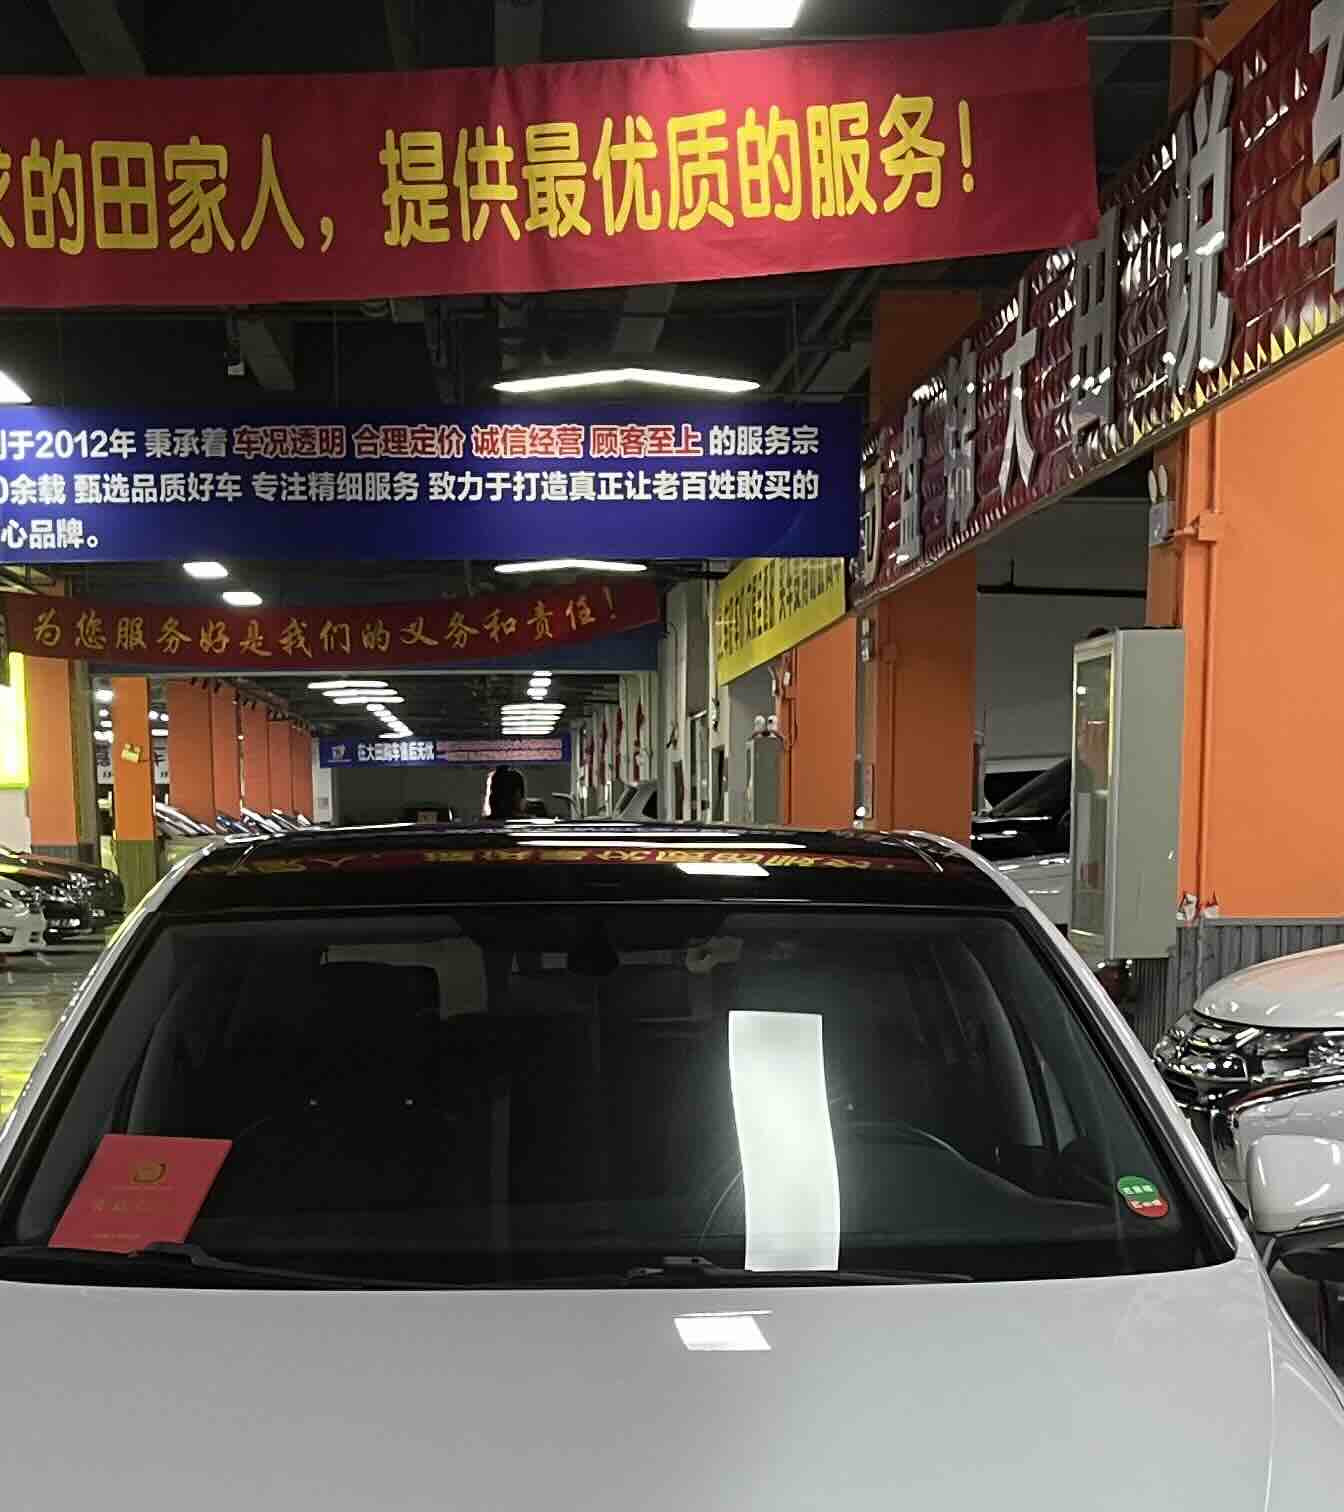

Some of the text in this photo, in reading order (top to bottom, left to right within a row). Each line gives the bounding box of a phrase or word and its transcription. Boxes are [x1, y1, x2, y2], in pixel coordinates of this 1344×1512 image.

[144, 425, 227, 461] 秉承着
[353, 425, 465, 460] 合理定价
[471, 425, 585, 460] 诚信经营
[589, 424, 703, 459] 顾客至上
[707, 425, 820, 457] 的服务宗
[73, 471, 243, 504] 甄选品质好车
[251, 470, 420, 503] 专注精细服务
[428, 469, 820, 502] 致力于打造真正让老百姓敢买的
[32, 587, 619, 657] 为您服务好是我们的义务和责任！
